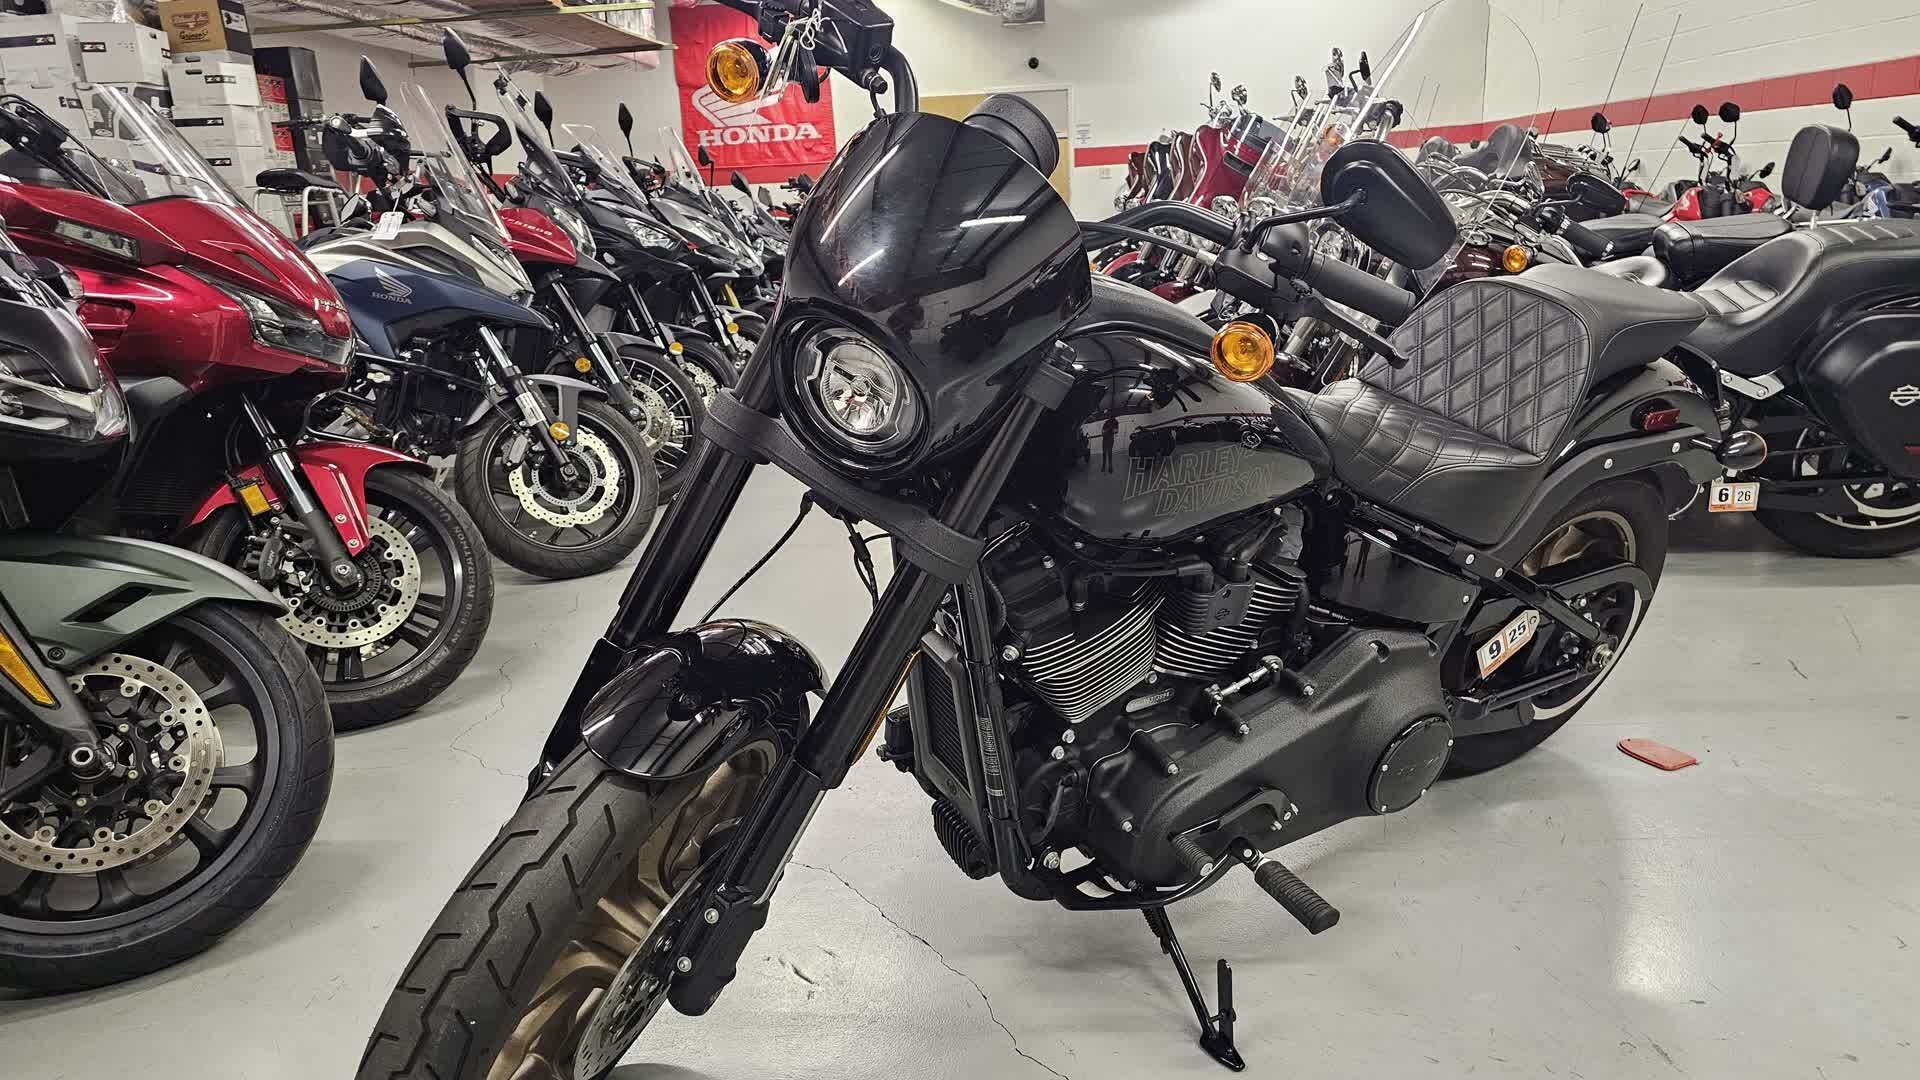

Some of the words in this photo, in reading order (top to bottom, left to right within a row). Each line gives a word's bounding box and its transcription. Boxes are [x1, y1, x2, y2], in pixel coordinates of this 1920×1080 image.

[696, 122, 822, 148] HONDA
[371, 291, 413, 305] HONDA
[1153, 464, 1273, 517] DAVIDSON
[1718, 488, 1730, 502] 6
[1737, 490, 1752, 502] 26
[1488, 639, 1502, 660] 9
[1508, 620, 1527, 644] 25
